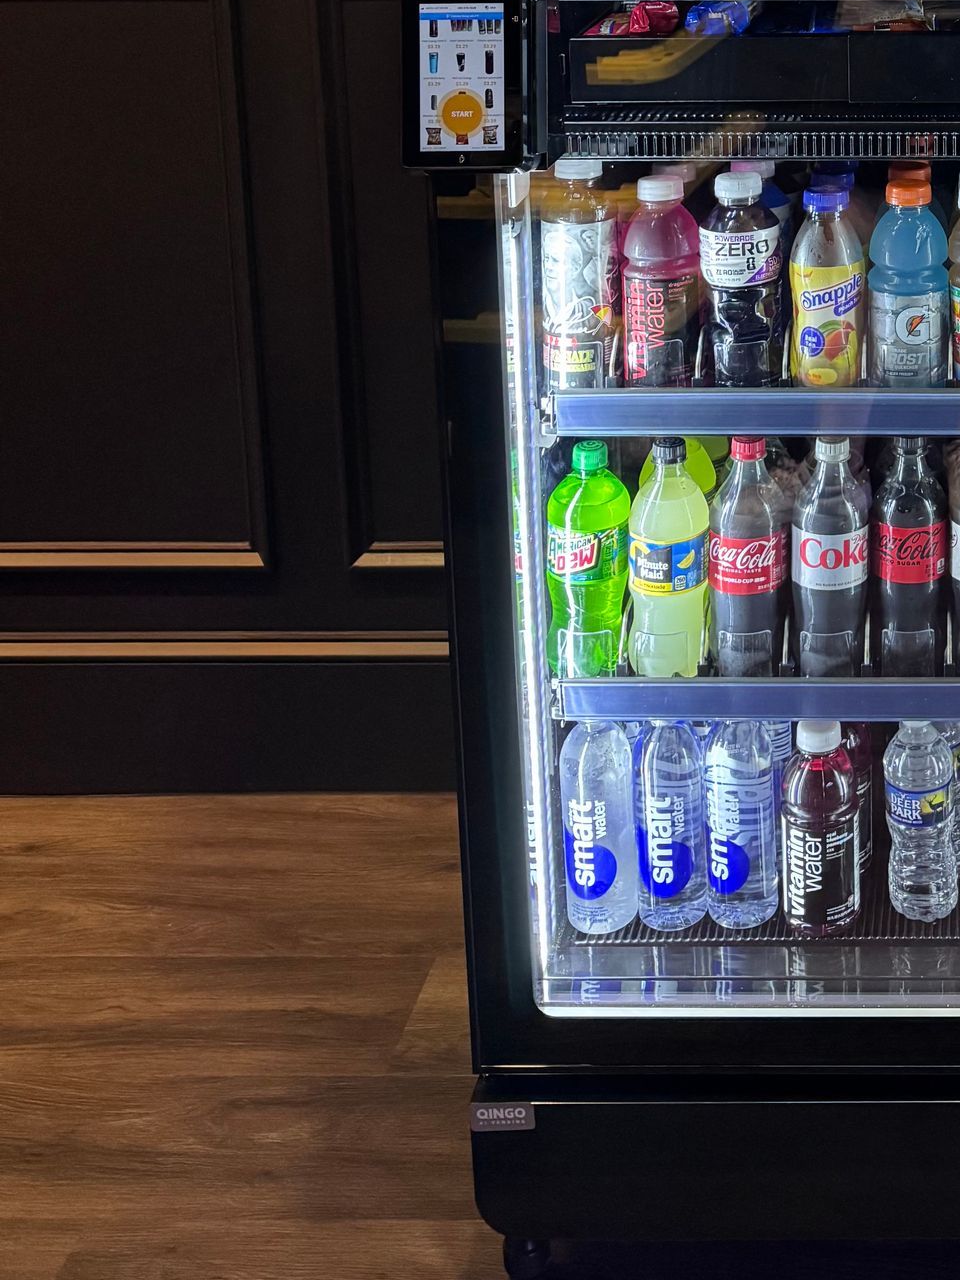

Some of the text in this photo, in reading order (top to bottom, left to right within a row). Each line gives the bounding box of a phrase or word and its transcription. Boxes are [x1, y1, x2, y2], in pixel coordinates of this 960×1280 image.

[451, 110, 474, 118] START
[714, 234, 755, 243] POWERADE
[715, 238, 770, 257] ZERO
[802, 273, 863, 310] Snapple
[645, 280, 665, 349] water
[895, 305, 931, 346] G
[637, 556, 669, 571] Minute
[709, 535, 780, 570] Coca-Cola
[799, 537, 868, 570] Coke
[640, 566, 664, 580] Maid
[594, 799, 607, 840] water
[674, 795, 685, 837] water
[890, 794, 921, 810] DEER
[890, 805, 922, 820] PARK
[567, 798, 596, 888] smart
[645, 794, 674, 885] smart
[706, 788, 729, 882] smart
[788, 827, 805, 918] vitamin
[804, 832, 823, 893] water
[476, 1107, 526, 1120] QINGO
